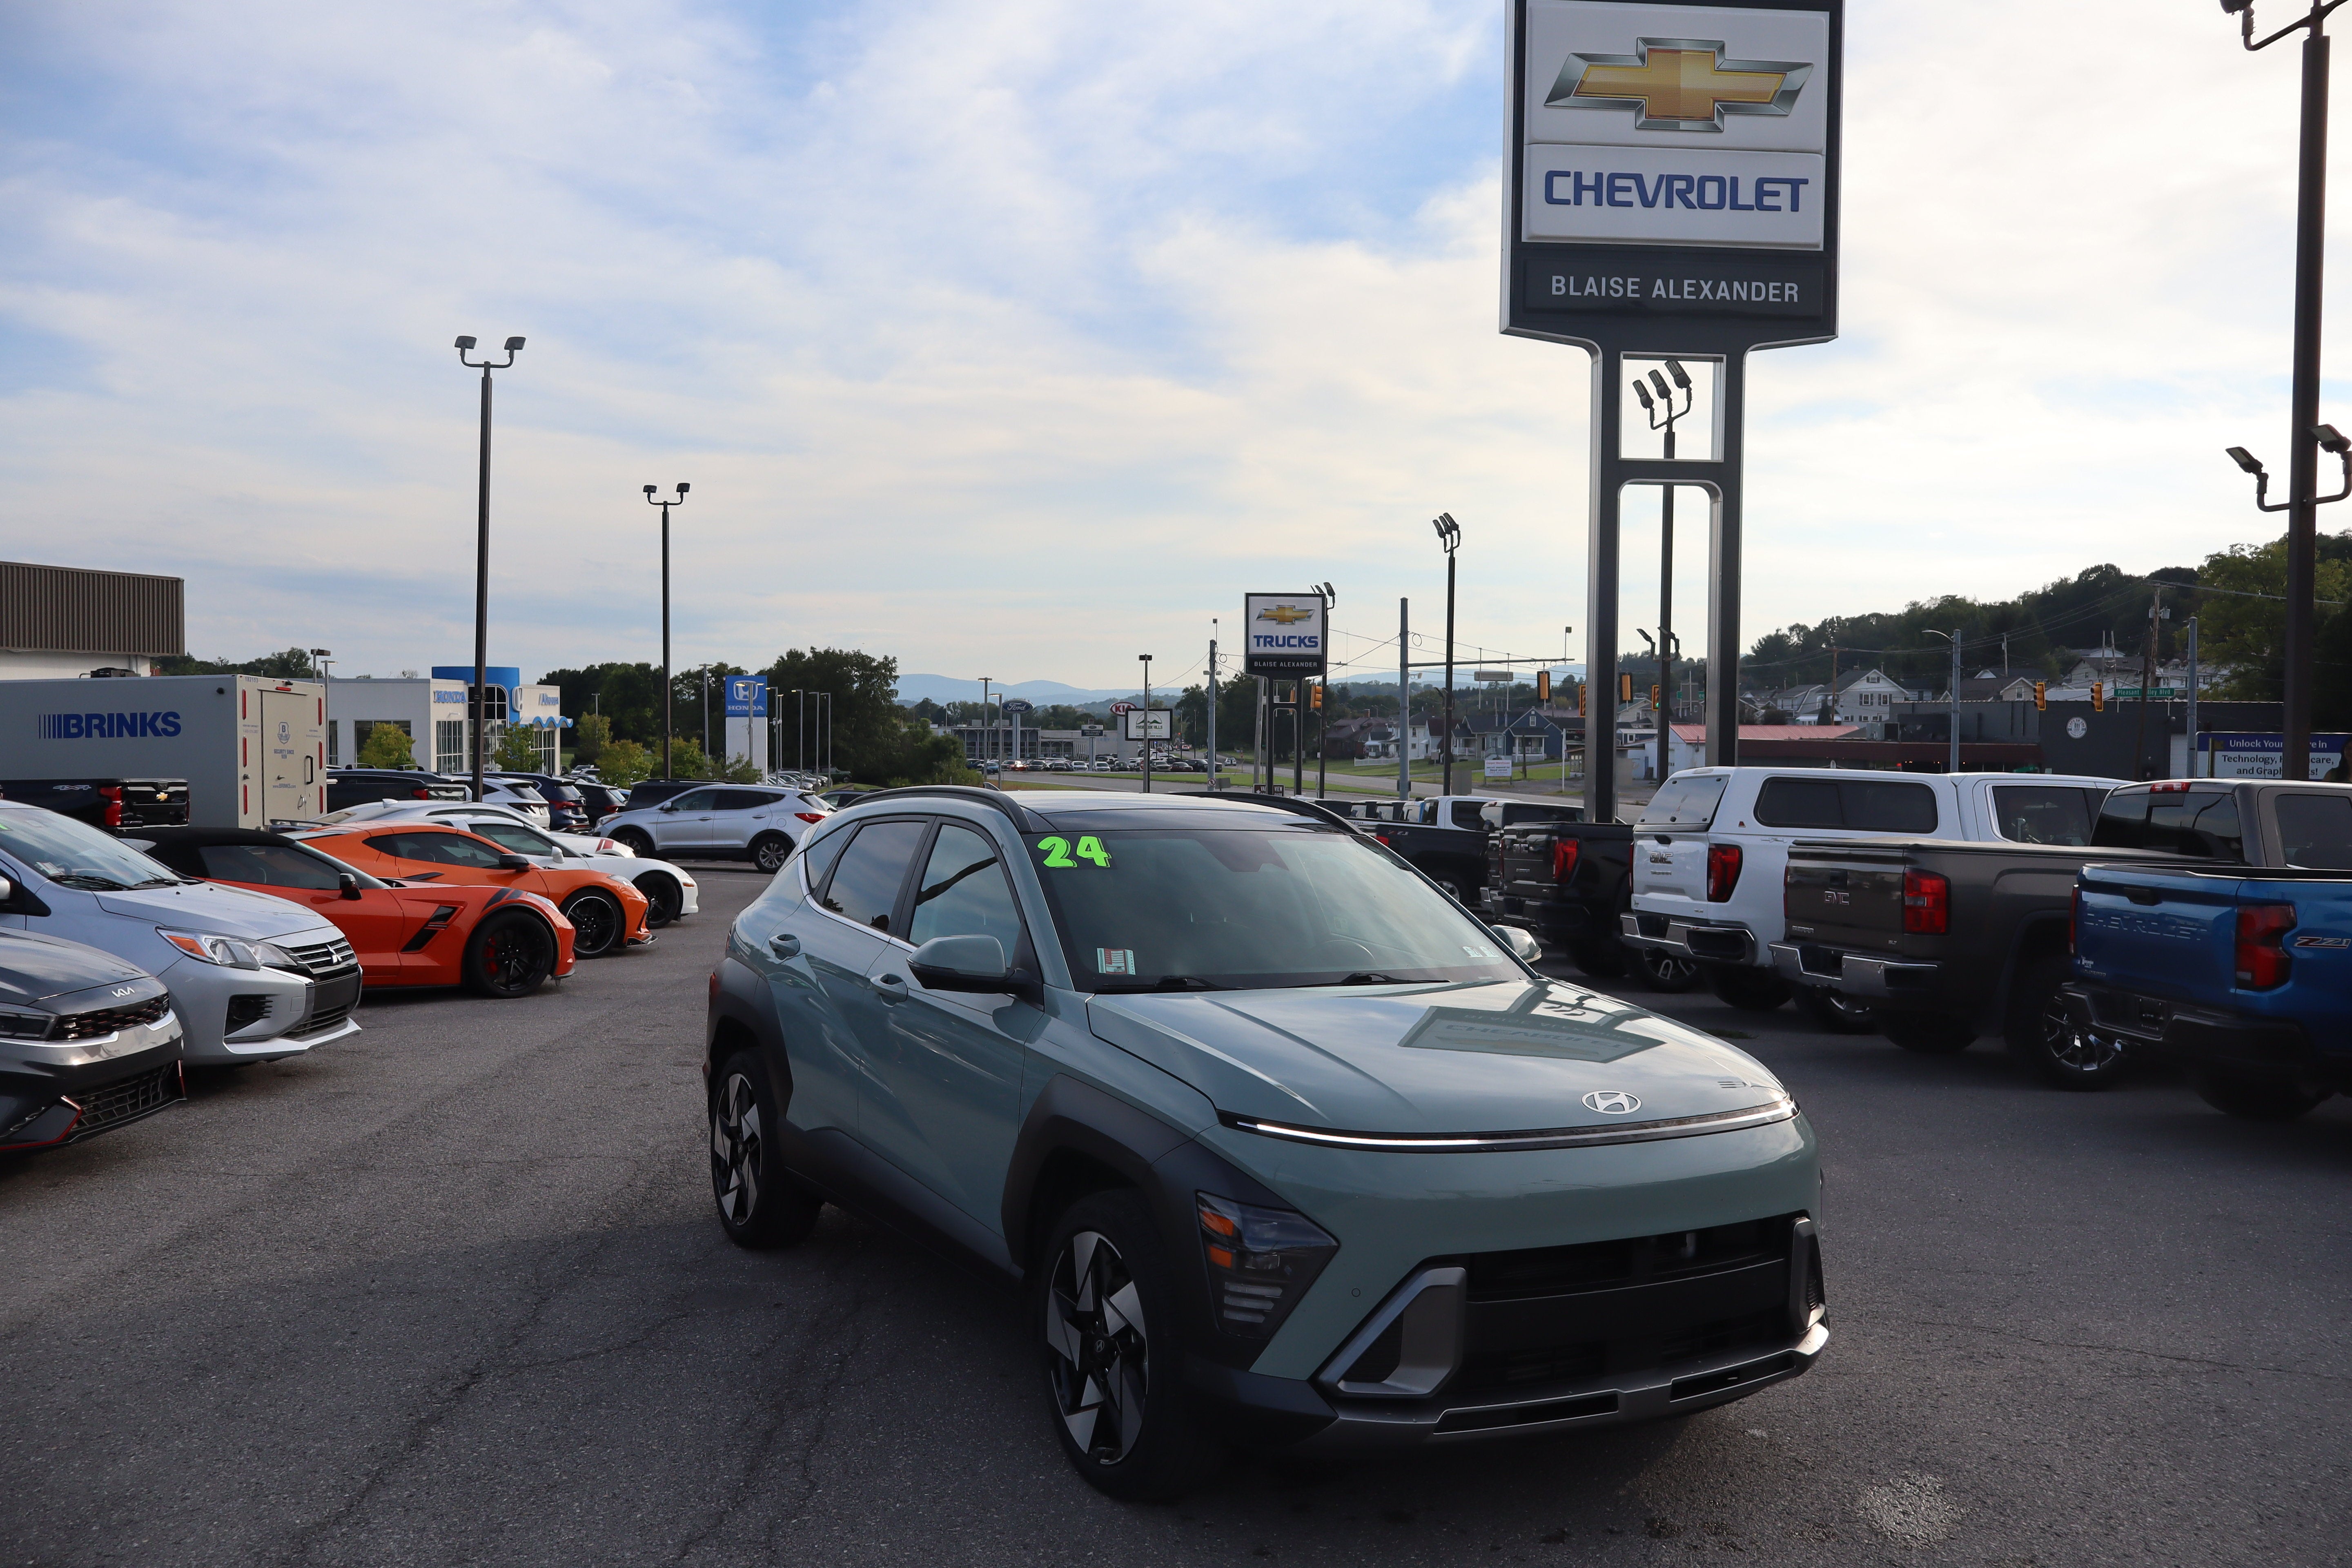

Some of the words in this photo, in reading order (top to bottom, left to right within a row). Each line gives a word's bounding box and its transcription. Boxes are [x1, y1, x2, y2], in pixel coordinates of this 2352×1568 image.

[1545, 169, 1809, 212] CHEVROLET
[1551, 276, 1641, 298] BLAISE
[1651, 278, 1799, 303] ALEXANDER
[1253, 635, 1319, 648] TRUCKS
[434, 690, 467, 704] HONDA
[1007, 702, 1027, 710] Ford
[63, 711, 182, 739] BRINKS
[2229, 739, 2261, 748] Unlock
[2263, 740, 2283, 748] Your
[2318, 740, 2327, 748] in
[2222, 755, 2277, 765] Technology,
[1037, 835, 1112, 868] 24
[1650, 852, 1673, 864] GMC
[1824, 891, 1850, 906] GMC
[1792, 925, 1814, 934] SIERRA
[2084, 913, 2207, 941] CHEVROLET
[2294, 936, 2352, 949] Z71
[111, 986, 135, 998] KIA
